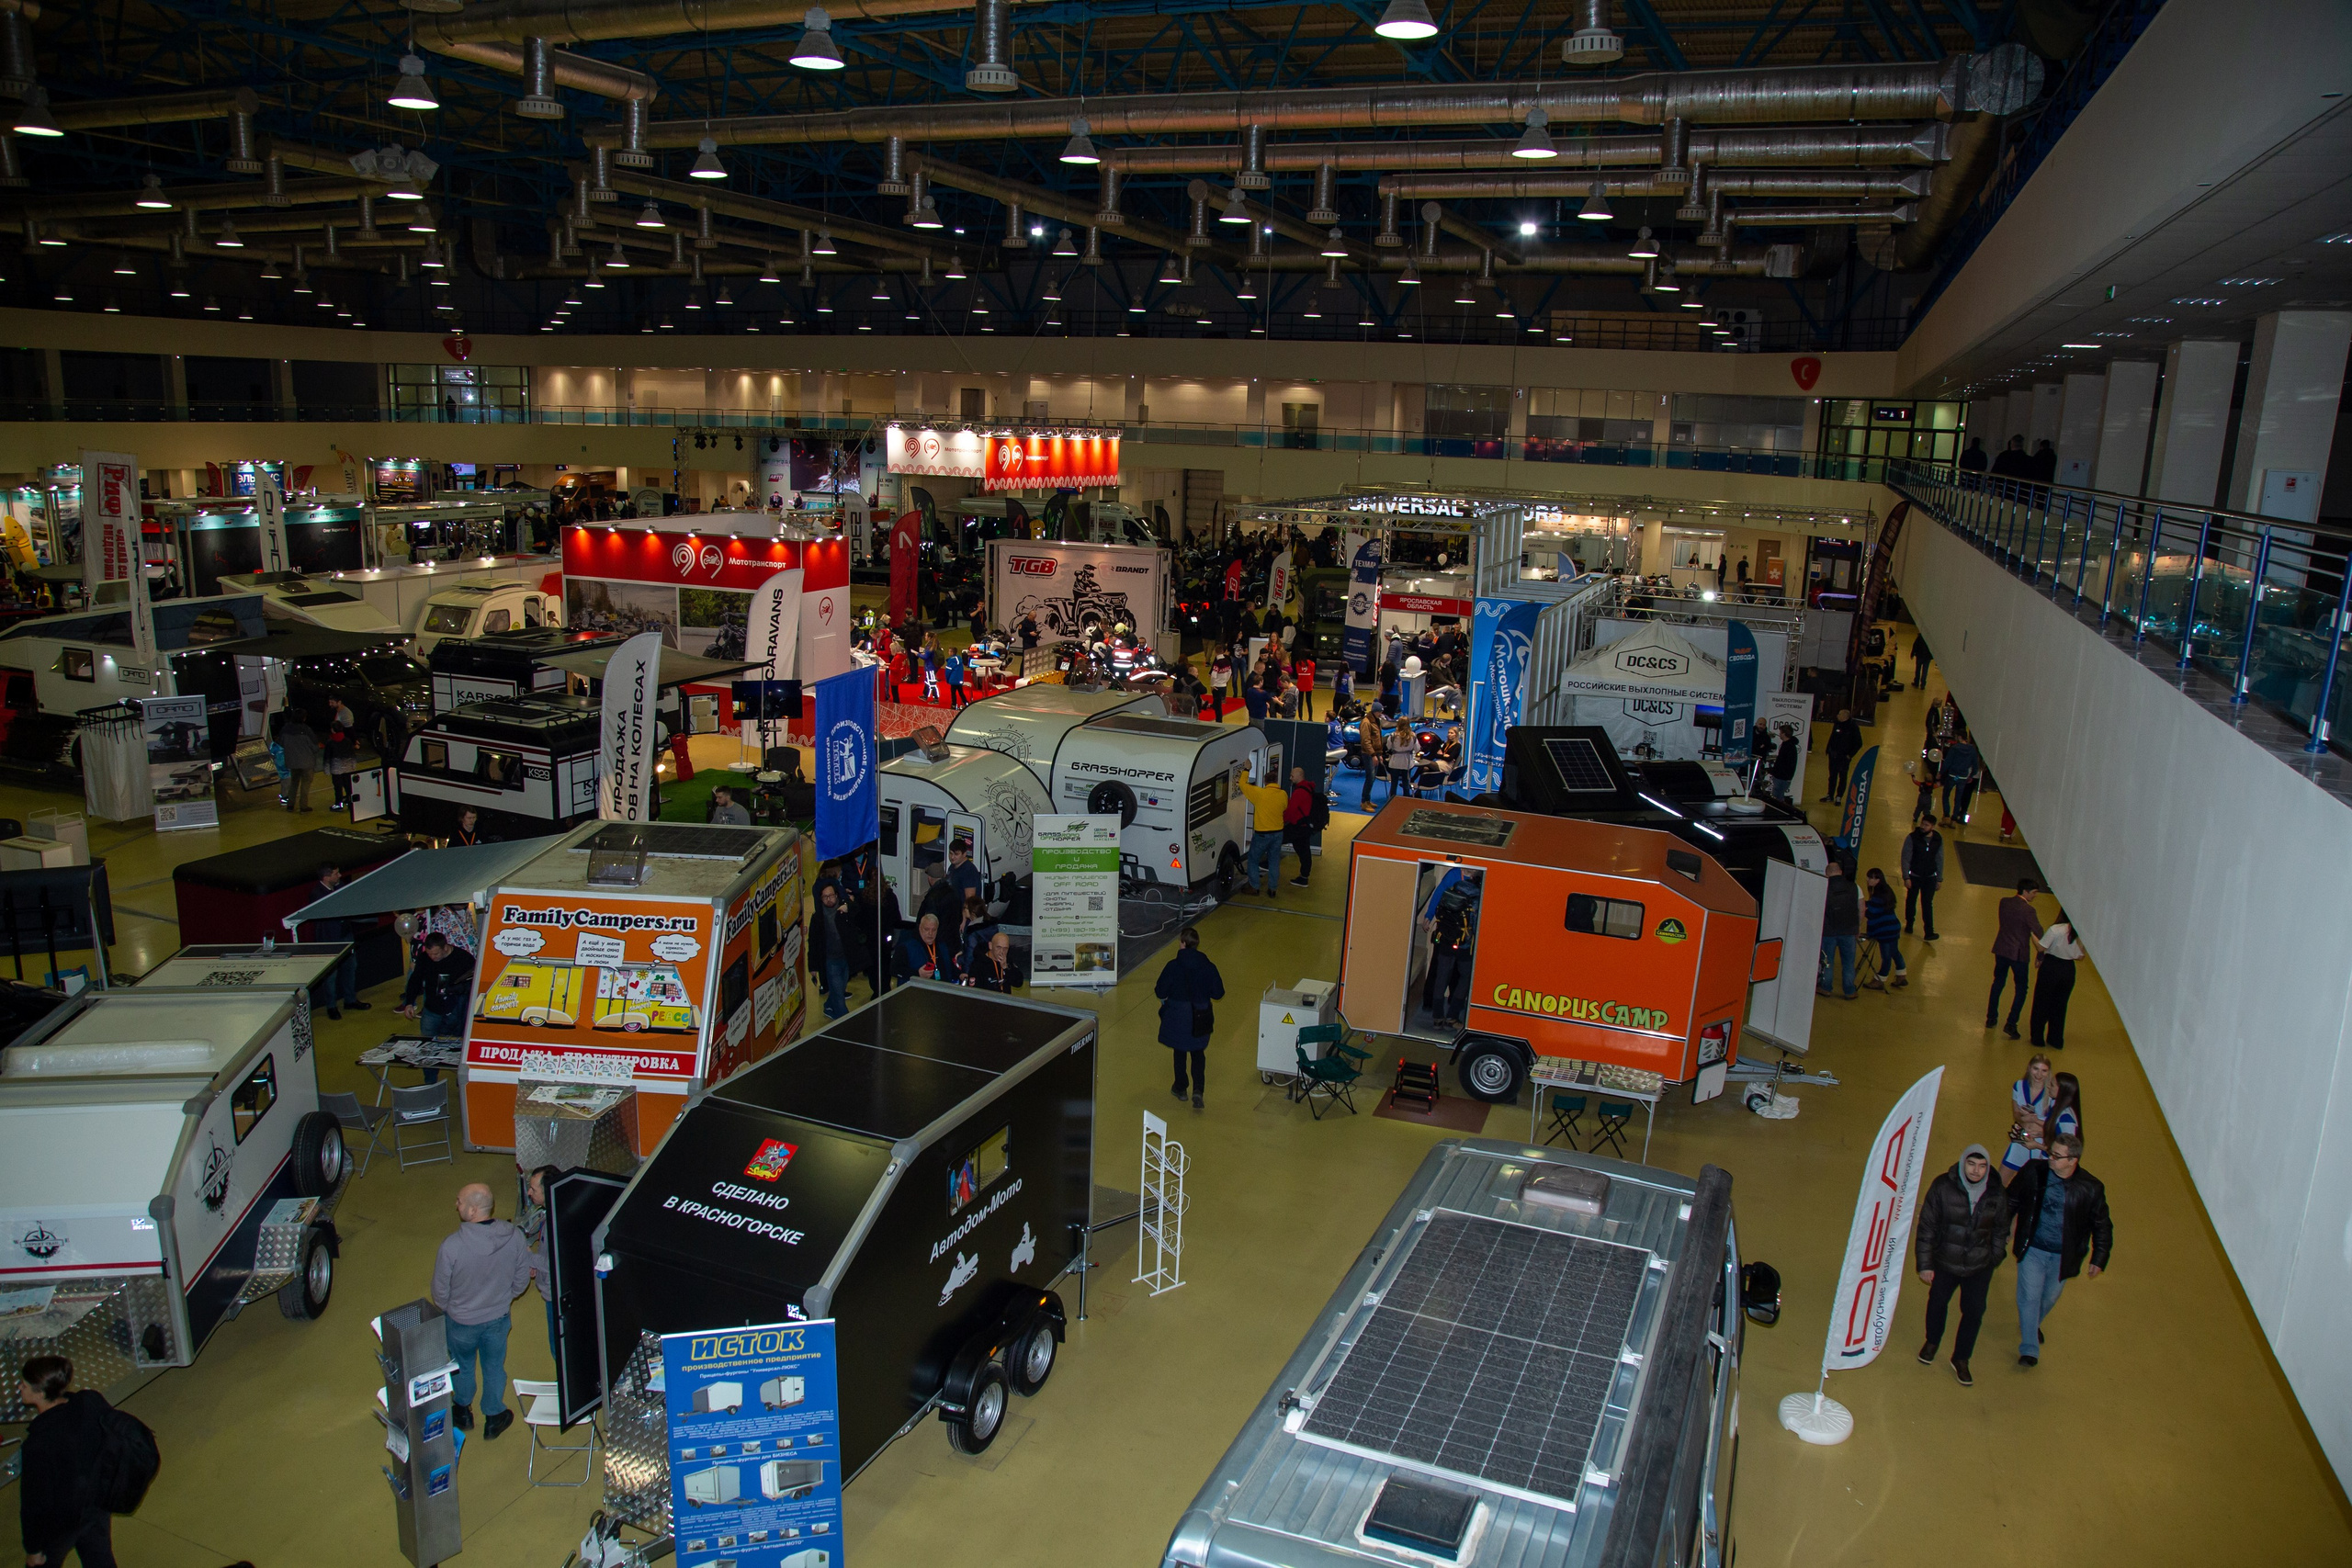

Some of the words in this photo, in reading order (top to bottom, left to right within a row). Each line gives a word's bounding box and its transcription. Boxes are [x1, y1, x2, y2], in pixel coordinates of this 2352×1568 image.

[944, 446, 982, 455] Мототранспорт
[729, 557, 786, 570] Мототранспорт
[1012, 557, 1057, 574] TGB
[1115, 566, 1149, 574] BRANDT
[1273, 569, 1285, 599] TGB
[1399, 597, 1442, 606] ЯРОСЛАВСКАЯ
[764, 588, 784, 681] CARAVANS
[1626, 655, 1678, 671] DC&CS
[1567, 681, 1626, 693] РОССИЙСКИЕ
[1629, 685, 1688, 697] ВЫХЛОПНЫЕ
[1690, 691, 1726, 702] СИСТЕМ
[630, 659, 647, 756] КОЛЕСАХ
[528, 767, 550, 781] KS29
[613, 710, 627, 815] ПРОДАЖА
[1071, 761, 1175, 783] GRASSHOPPER
[629, 761, 640, 790] НА
[1849, 770, 1869, 849] СВОБОДА
[725, 853, 798, 945] FamilyCampers.ru
[503, 906, 697, 931] FamilyCampers.ru
[651, 1010, 689, 1022] PEACE
[710, 1180, 790, 1212] СДЕЛАНО
[662, 1195, 679, 1210] В
[681, 1199, 806, 1247] КРАСНОГОРСКЕ
[929, 1177, 1024, 1264] Автодом-Мото
[1871, 1287, 1886, 1352] Автобусные
[1882, 1237, 1897, 1283] решения
[691, 1328, 806, 1361] ИСТОК
[682, 1357, 763, 1372] производственное
[765, 1352, 821, 1364] предприятие
[772, 1450, 797, 1459] БИЗНЕСА
